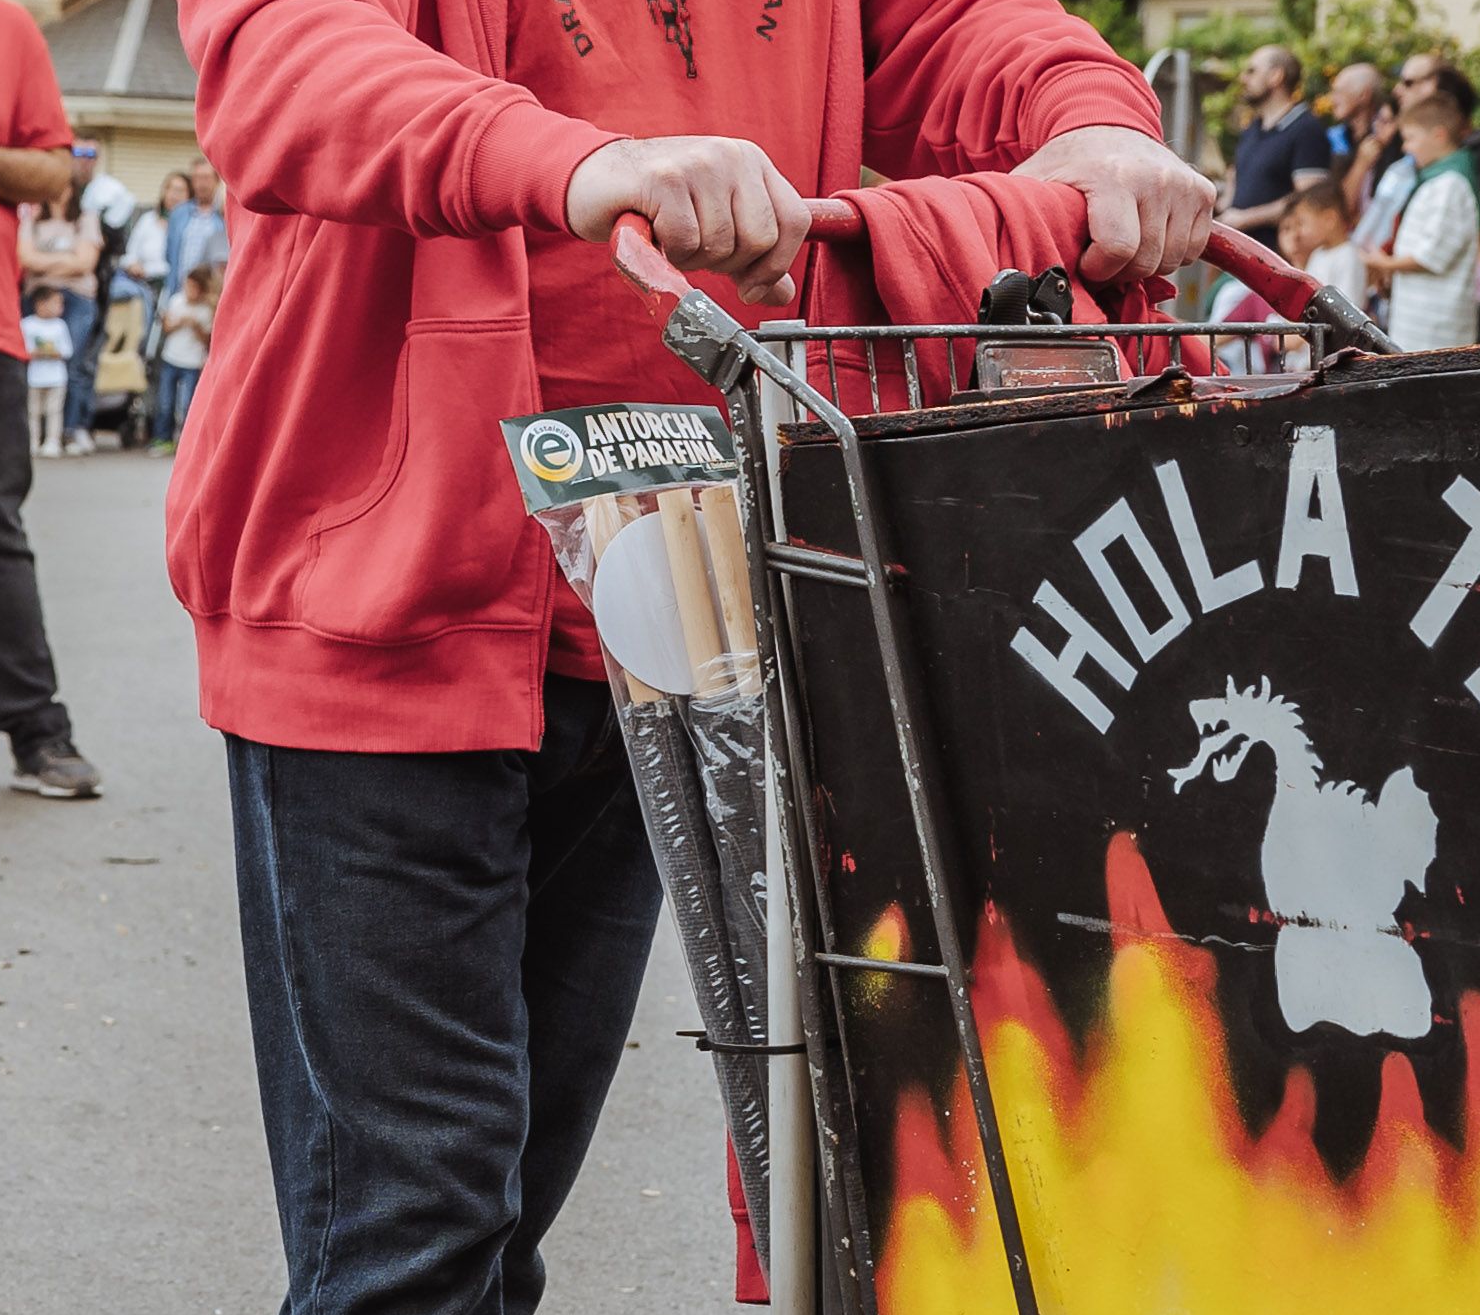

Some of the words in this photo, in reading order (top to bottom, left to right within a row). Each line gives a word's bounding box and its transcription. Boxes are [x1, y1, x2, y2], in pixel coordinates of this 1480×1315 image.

[585, 411, 714, 446] ANTORCHA
[586, 445, 622, 477] DE
[619, 440, 724, 470] PARAFINA
[1010, 425, 1359, 734] HOLA
